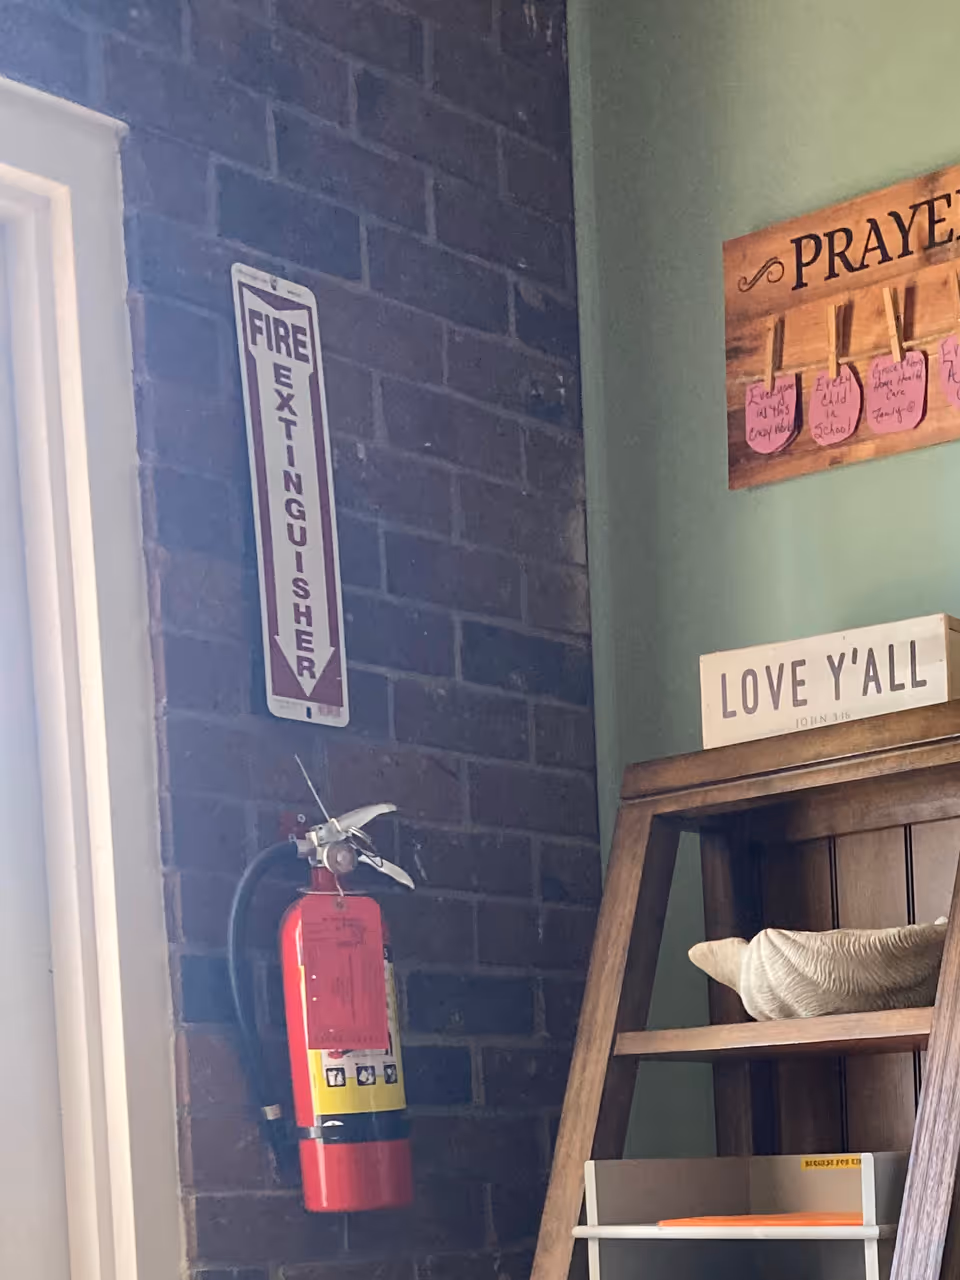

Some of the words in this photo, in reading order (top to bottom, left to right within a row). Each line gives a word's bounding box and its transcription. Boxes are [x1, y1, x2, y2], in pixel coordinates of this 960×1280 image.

[248, 308, 310, 364] FIRE
[273, 362, 316, 679] EXTINGUISHER
[721, 659, 808, 719] LOVE
[826, 640, 927, 701] Y'ALL
